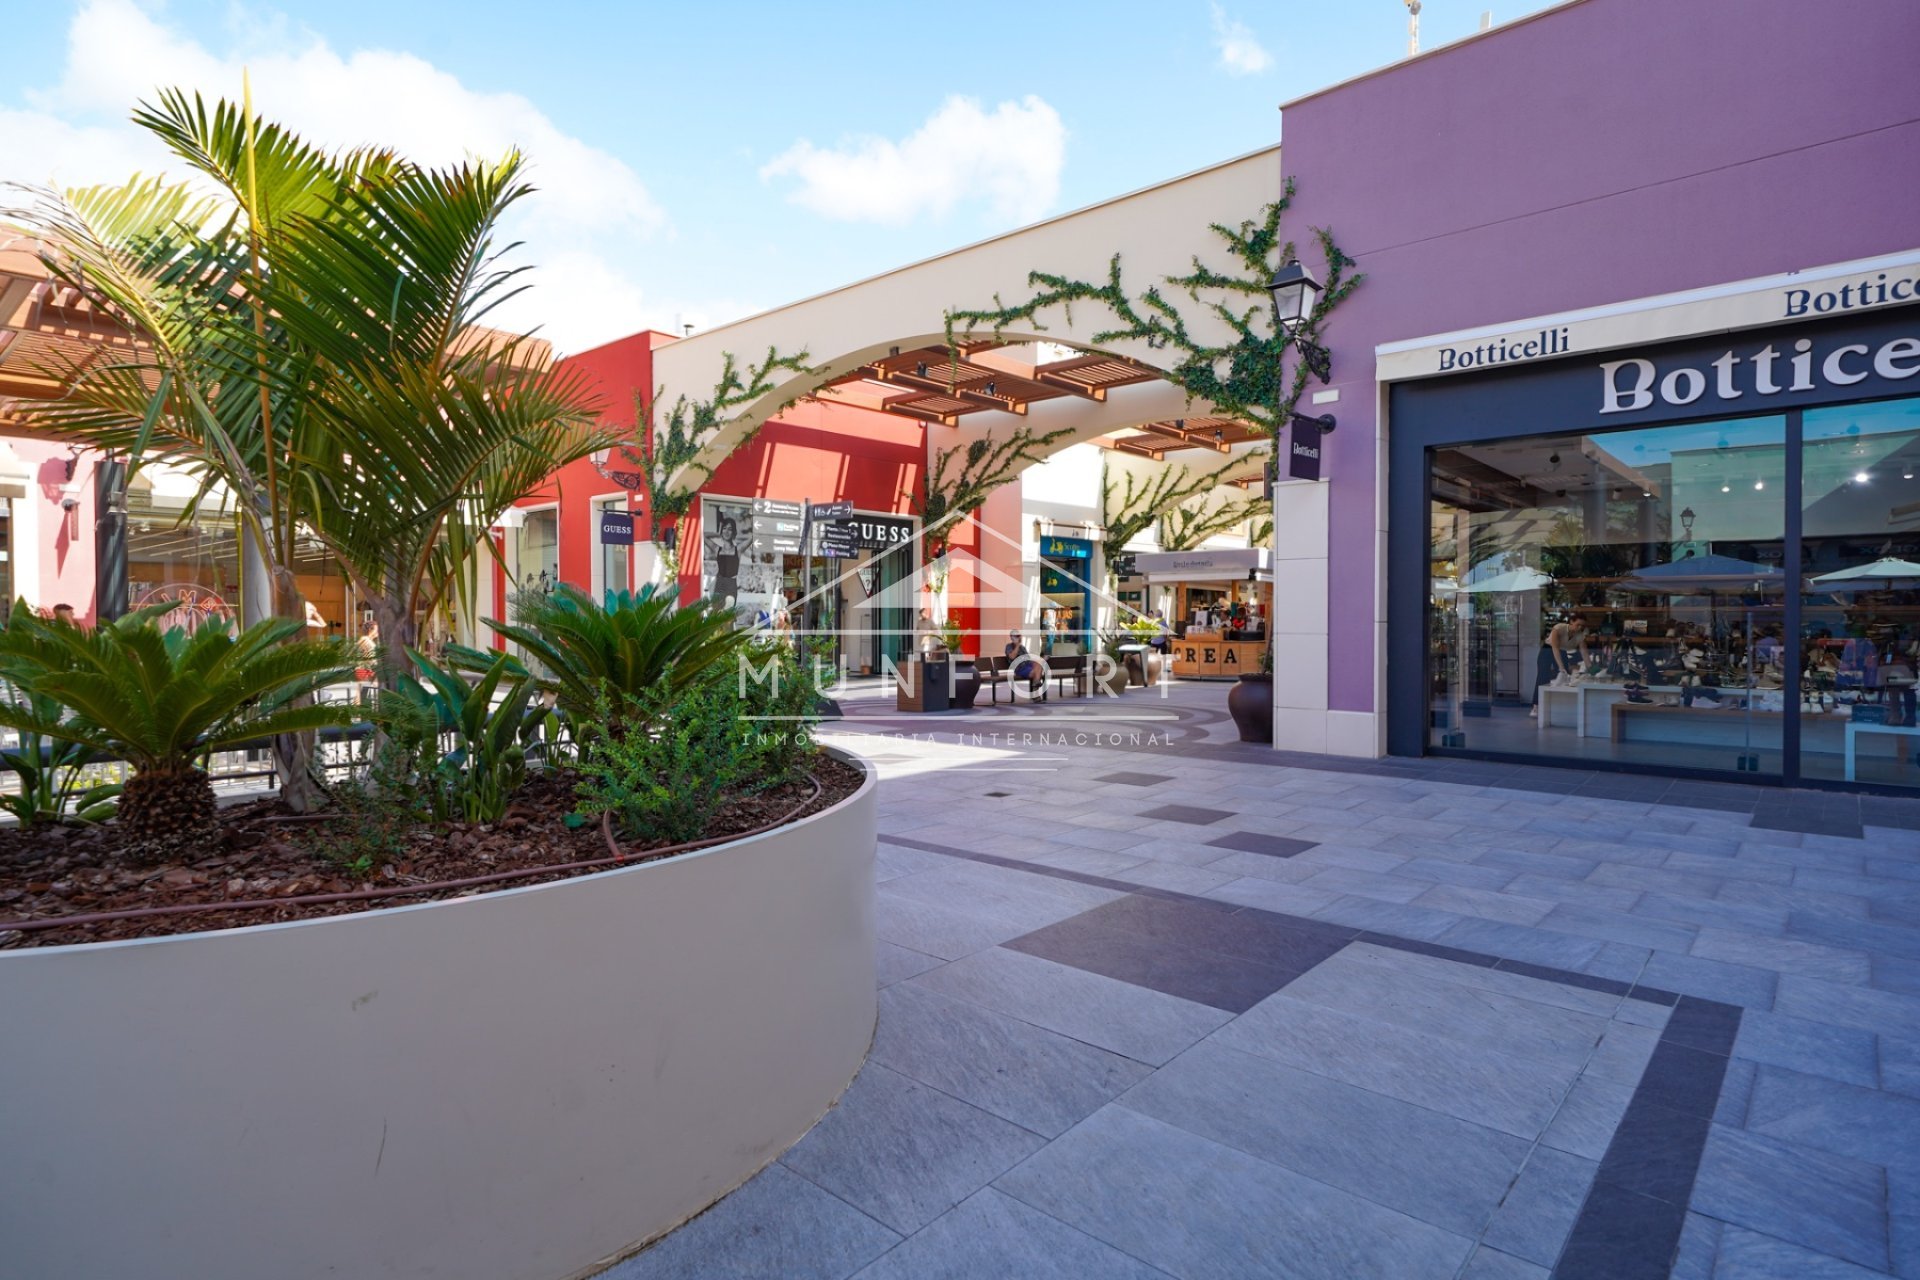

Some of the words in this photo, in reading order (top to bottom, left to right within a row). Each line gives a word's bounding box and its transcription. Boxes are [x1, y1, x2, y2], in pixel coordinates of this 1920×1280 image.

[1438, 328, 1569, 371] Botticelli
[764, 501, 771, 514] 2
[603, 525, 632, 534] GUESS
